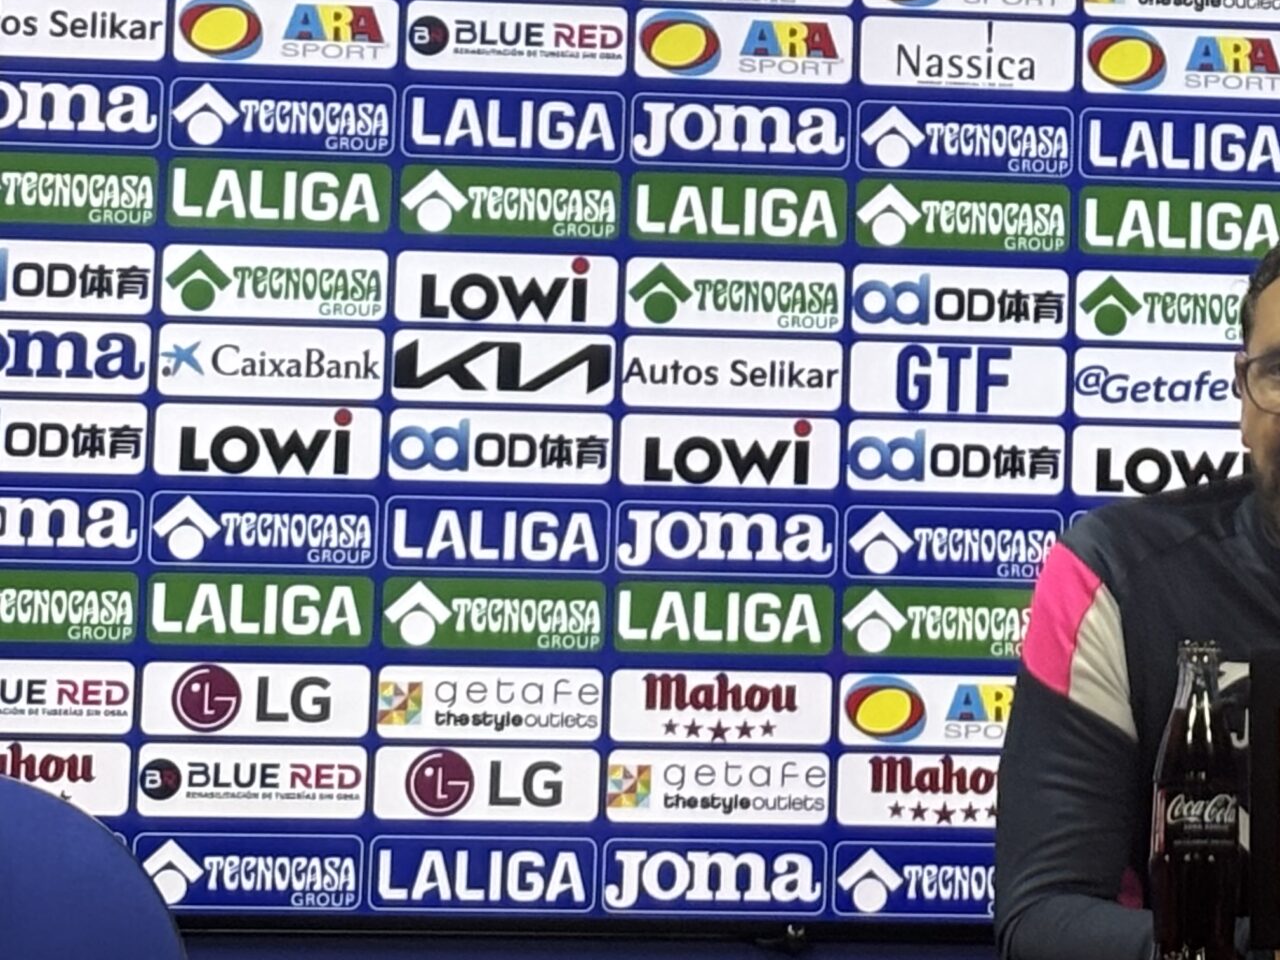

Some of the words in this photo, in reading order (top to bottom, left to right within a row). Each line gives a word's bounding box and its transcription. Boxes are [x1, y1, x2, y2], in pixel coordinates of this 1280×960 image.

[49, 11, 163, 40] Selikar
[282, 4, 384, 42] ARA
[454, 21, 545, 47] BLUE
[553, 23, 623, 49] RED
[740, 19, 838, 59] ARA
[281, 41, 381, 60] SPORT
[738, 57, 836, 75] SPORT
[896, 22, 1036, 82] Nassica
[240, 100, 389, 137] TECNOCASA
[411, 97, 615, 151] LALIGA
[325, 135, 388, 151] GROUP
[927, 123, 1068, 159] TECNOCASA
[1007, 158, 1069, 174] GROUP
[1, 172, 153, 209] TECNOCASA
[172, 168, 380, 221] LALIGA
[468, 186, 615, 223] TECNOCASA
[89, 208, 152, 225] GROUP
[553, 221, 615, 238] GROUP
[636, 184, 838, 238] LALIGA
[921, 200, 1065, 237] TECNOCASA
[1004, 236, 1064, 251] GROUP
[12, 261, 150, 300] OD体育
[234, 266, 382, 303] TECNOCASA
[694, 278, 838, 315] TECNOCASA
[318, 302, 381, 317] GROUP
[778, 314, 838, 330] GROUP
[935, 288, 1064, 325] OD体育
[212, 344, 381, 380] CaixaBank
[393, 340, 612, 392] KIA
[623, 357, 721, 386] Autos
[731, 360, 838, 389] Selikar
[897, 345, 1012, 414] GTF
[5, 421, 142, 459] OD体育
[474, 432, 608, 469] OD体育
[930, 443, 1060, 480] OD体育
[221, 513, 371, 550] TECNOCASA
[393, 509, 599, 562] LALIGA
[307, 548, 370, 564] GROUP
[152, 582, 361, 635] LALIGA
[452, 598, 600, 634] TECNOCASA
[619, 590, 822, 643] LALIGA
[537, 633, 599, 649] GROUP
[256, 676, 331, 724] LG
[435, 679, 599, 706] getafe
[643, 673, 797, 713] Mahou
[187, 762, 280, 788] BLUE
[289, 764, 361, 790] RED
[488, 760, 563, 808] LG
[663, 762, 826, 789] getafe
[205, 854, 356, 892] TECNOCASA
[378, 849, 585, 902] LALIGA
[291, 891, 355, 908] GROUP
